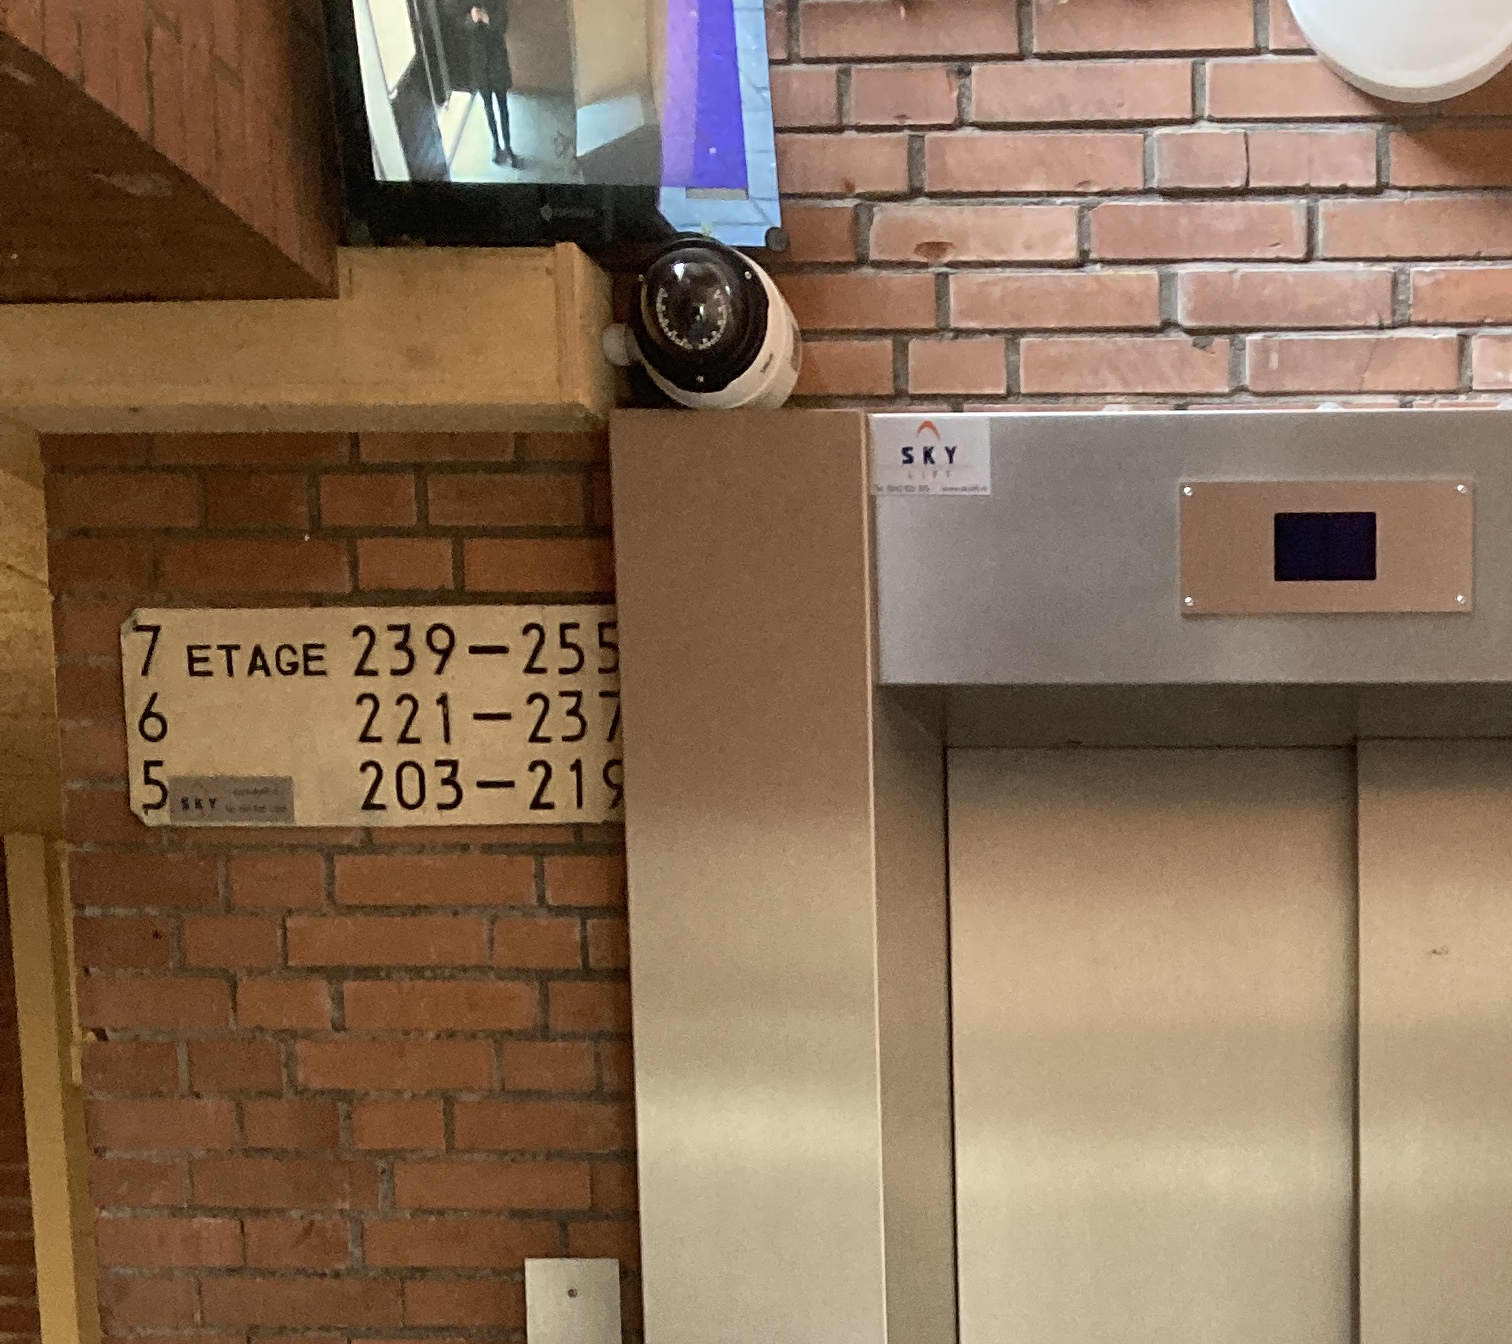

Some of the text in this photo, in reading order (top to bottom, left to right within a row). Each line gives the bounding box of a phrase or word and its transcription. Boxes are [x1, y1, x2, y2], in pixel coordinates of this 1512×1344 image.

[901, 446, 957, 465] SKY
[132, 625, 162, 677] 7
[186, 643, 328, 677] ETAGE
[138, 691, 168, 742] 6
[141, 760, 168, 811] 5
